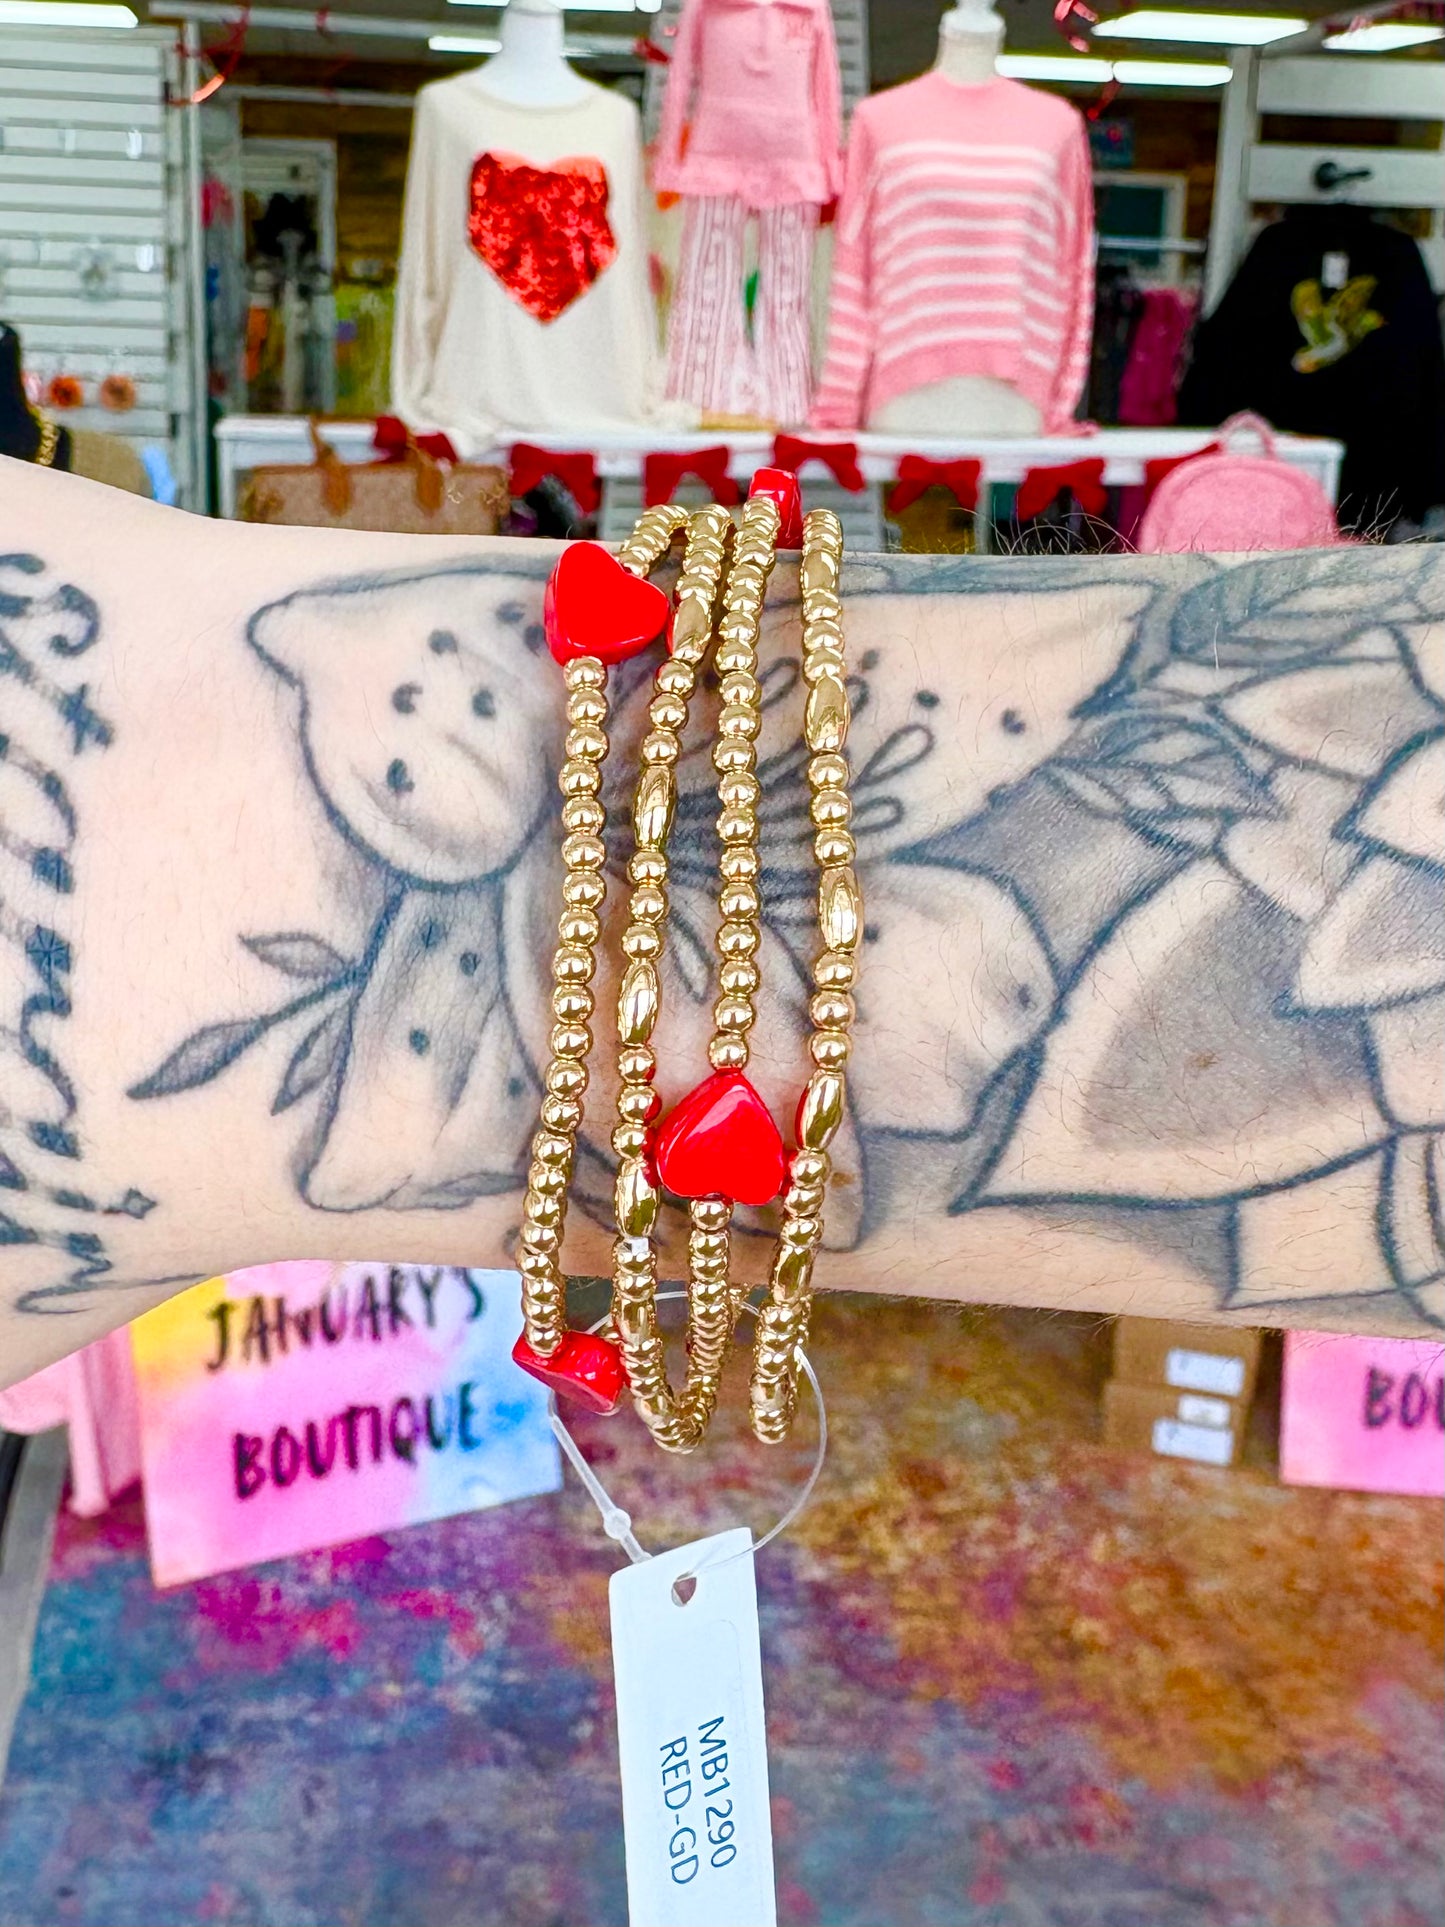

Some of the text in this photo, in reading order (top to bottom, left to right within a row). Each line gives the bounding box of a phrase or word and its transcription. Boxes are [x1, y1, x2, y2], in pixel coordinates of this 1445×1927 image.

[232, 1382, 481, 1500] BOUTIQUE
[660, 1736, 699, 1884] RED-GD
[698, 1716, 737, 1868] MB1290
